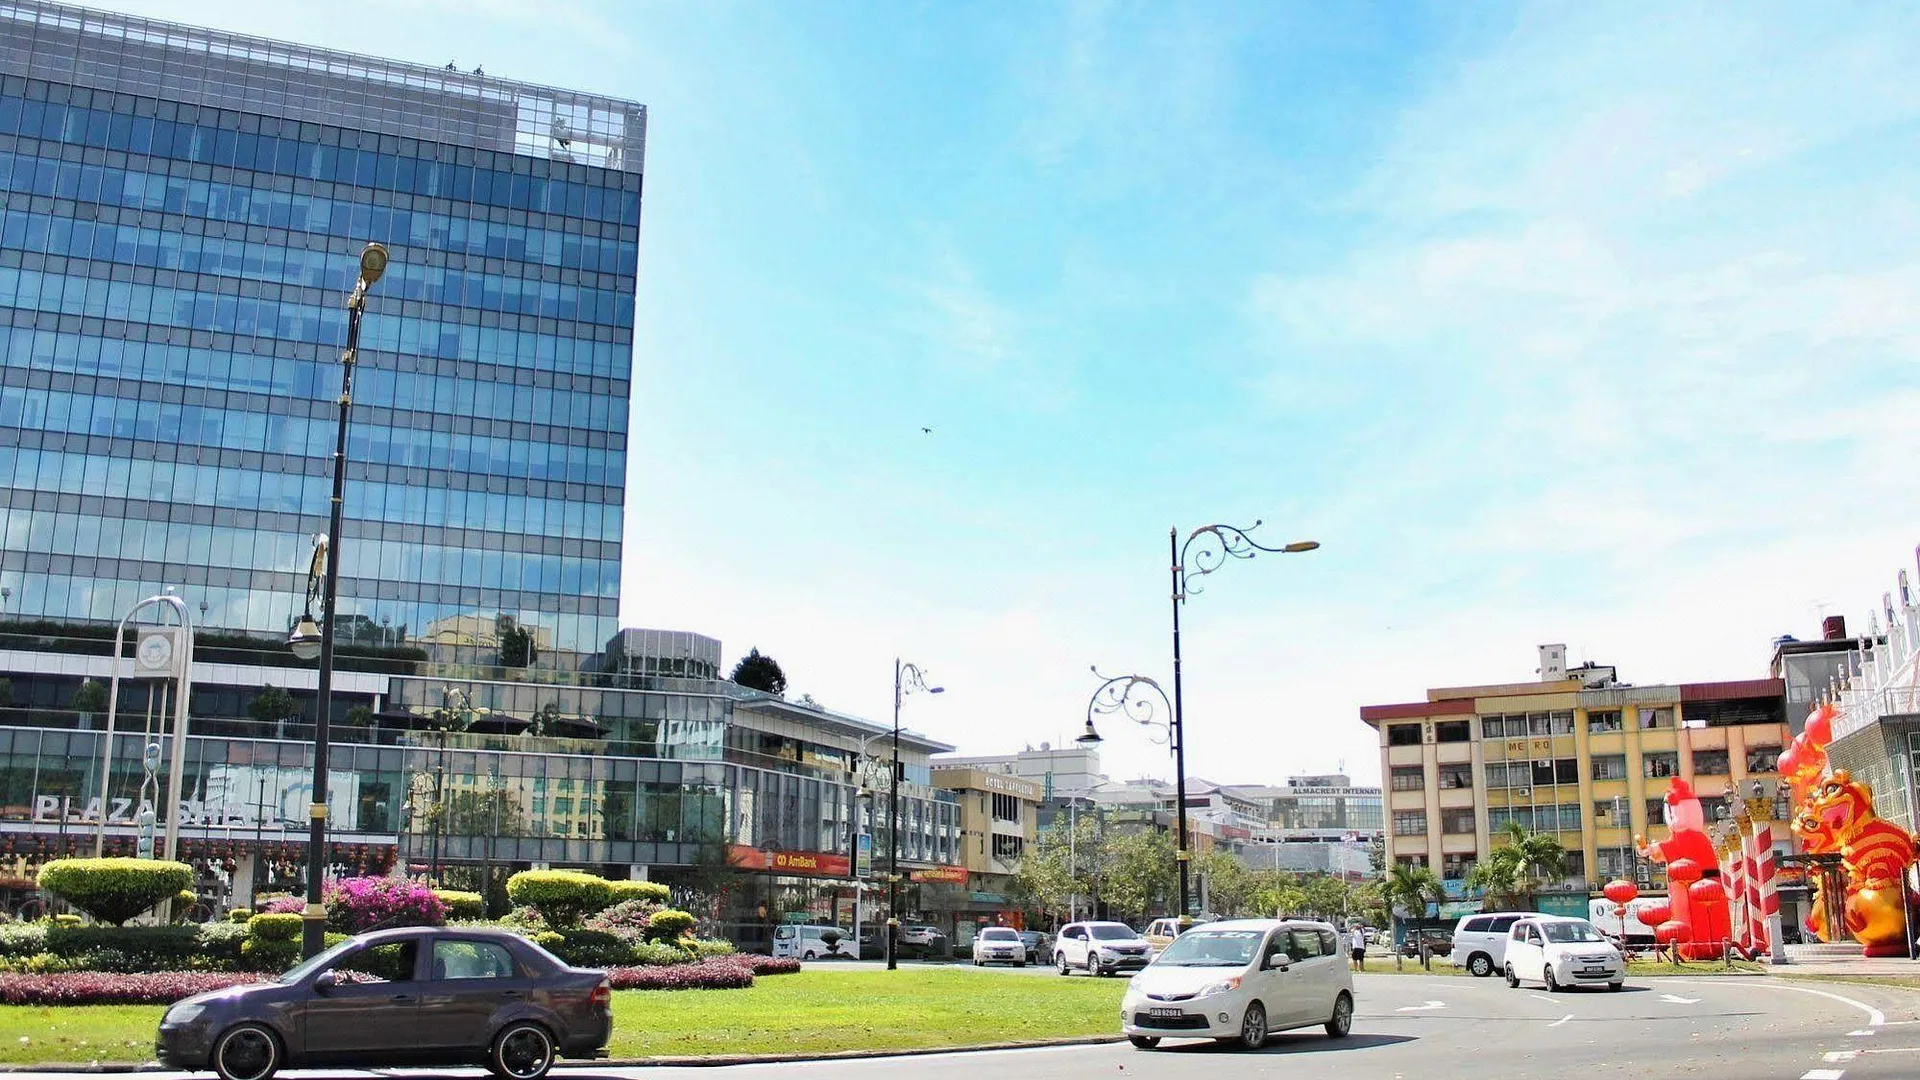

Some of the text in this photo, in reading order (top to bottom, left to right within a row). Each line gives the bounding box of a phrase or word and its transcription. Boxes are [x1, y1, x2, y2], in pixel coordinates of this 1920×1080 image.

[1292, 787, 1341, 796] ALMACREST
[36, 795, 156, 823] PLAZA
[788, 855, 818, 869] AmBank
